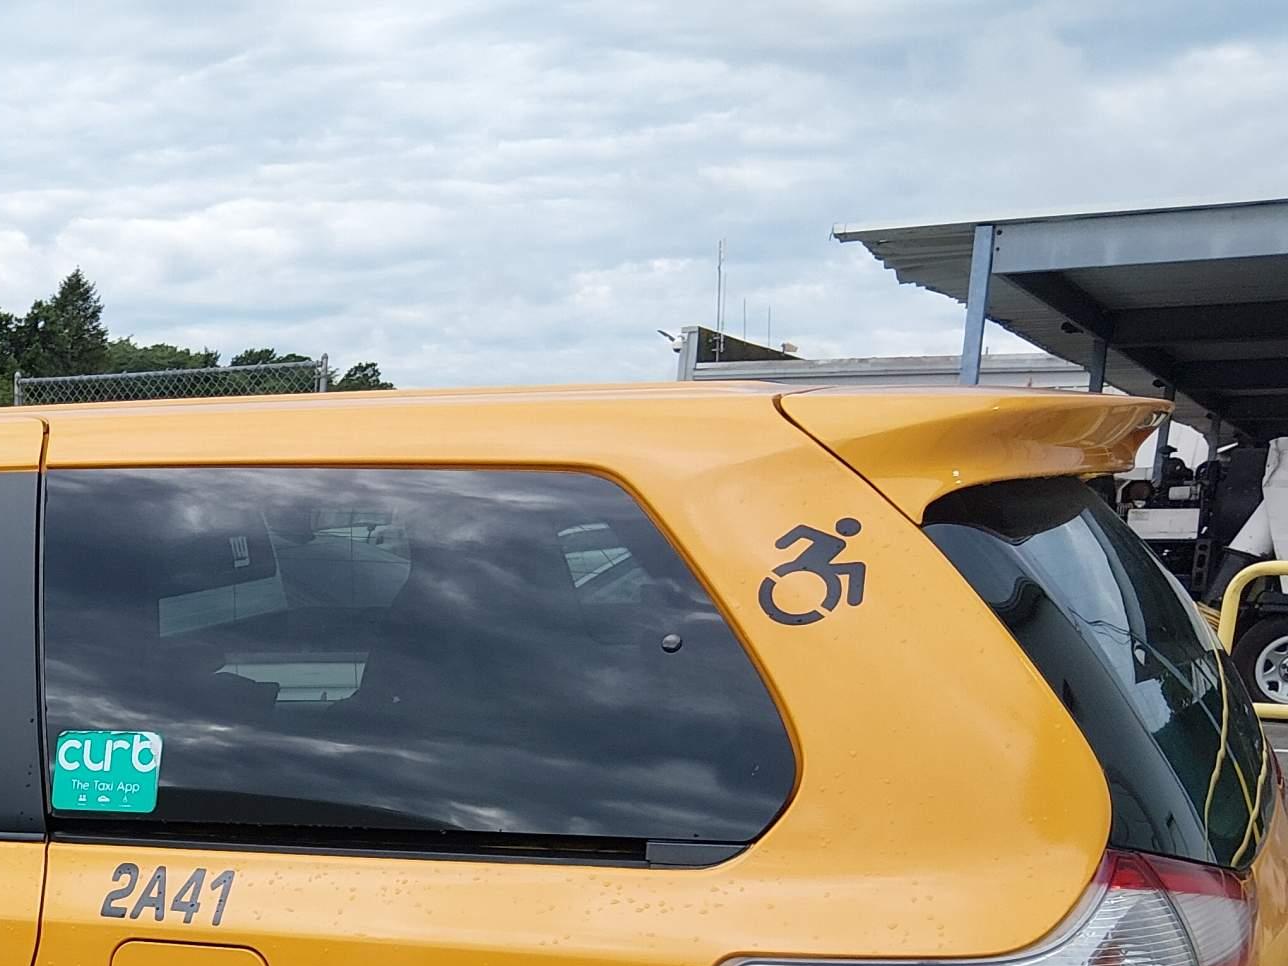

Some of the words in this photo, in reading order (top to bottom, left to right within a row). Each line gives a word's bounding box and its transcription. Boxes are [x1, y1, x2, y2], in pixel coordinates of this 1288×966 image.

[58, 734, 157, 773] curb
[71, 779, 90, 791] The
[94, 780, 114, 792] Taxi
[116, 781, 140, 794] App
[100, 862, 236, 927] 2A41
